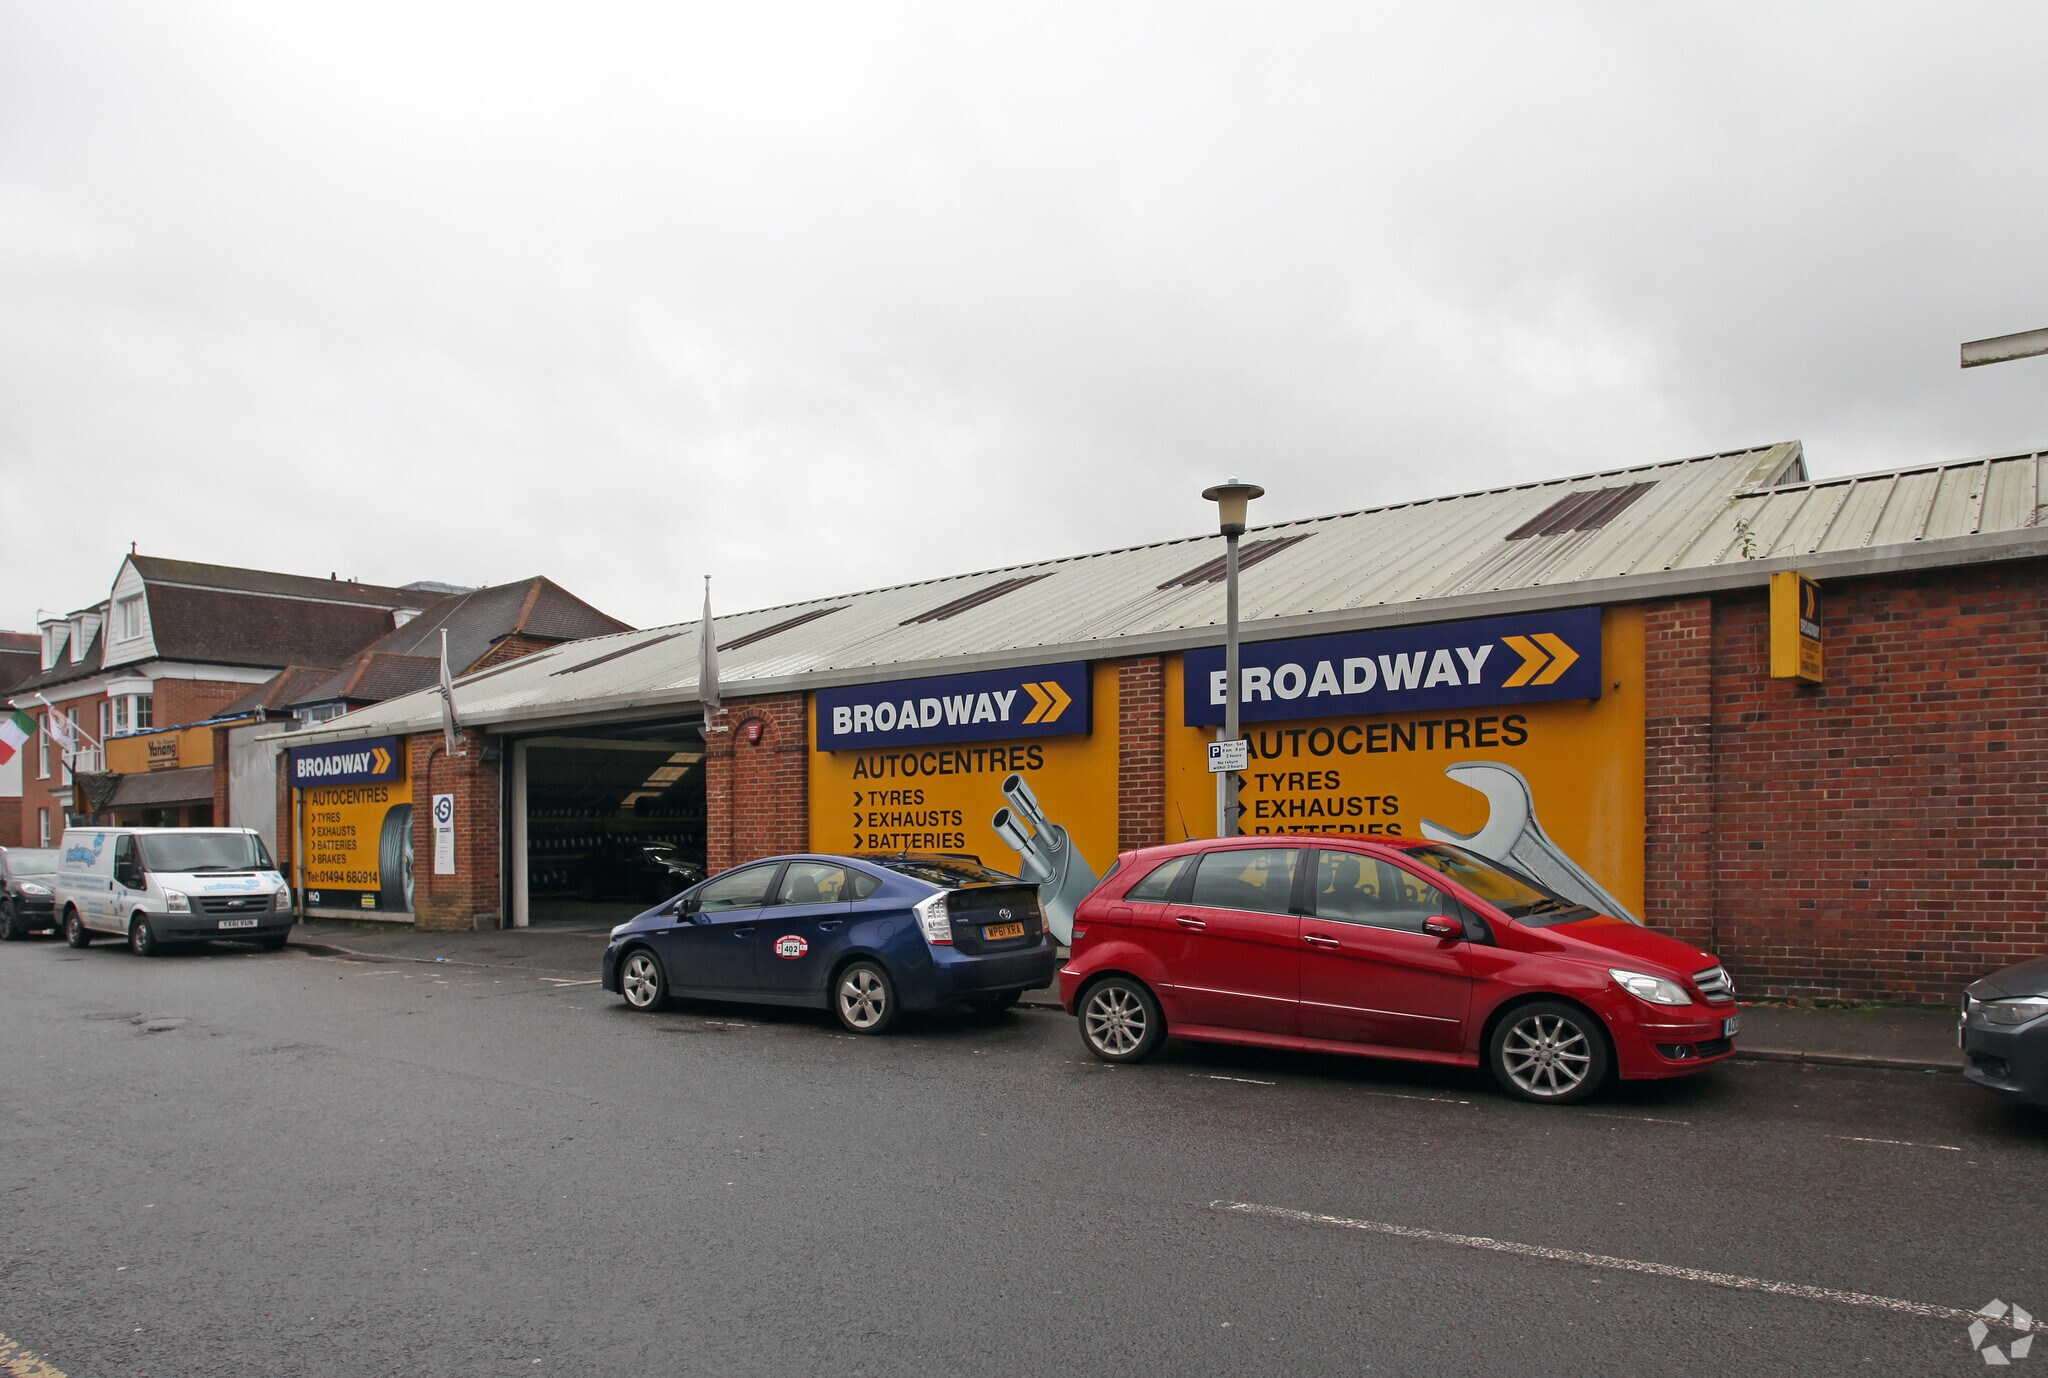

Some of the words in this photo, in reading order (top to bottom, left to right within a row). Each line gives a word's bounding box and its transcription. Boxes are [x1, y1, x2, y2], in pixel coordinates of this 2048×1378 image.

[833, 690, 1017, 735] BROADWAY
[148, 741, 176, 757] Yanang
[1212, 747, 1219, 757] P
[297, 752, 370, 778] BROADWAY
[853, 745, 1044, 780] AUTOCENTRES
[1255, 770, 1341, 792] TYRES
[312, 787, 388, 806] AUTOCENTRES
[868, 789, 924, 806] TYRES
[1255, 795, 1399, 819] EXHAUSTS
[317, 812, 340, 823] TYRES
[868, 810, 963, 828] EXHAUSTS
[317, 826, 356, 837] EXHAUSTS
[317, 840, 357, 851] BATTERIES
[868, 832, 965, 849] BATTERIES
[317, 854, 346, 865] BRAKES
[346, 872, 378, 884] 680914
